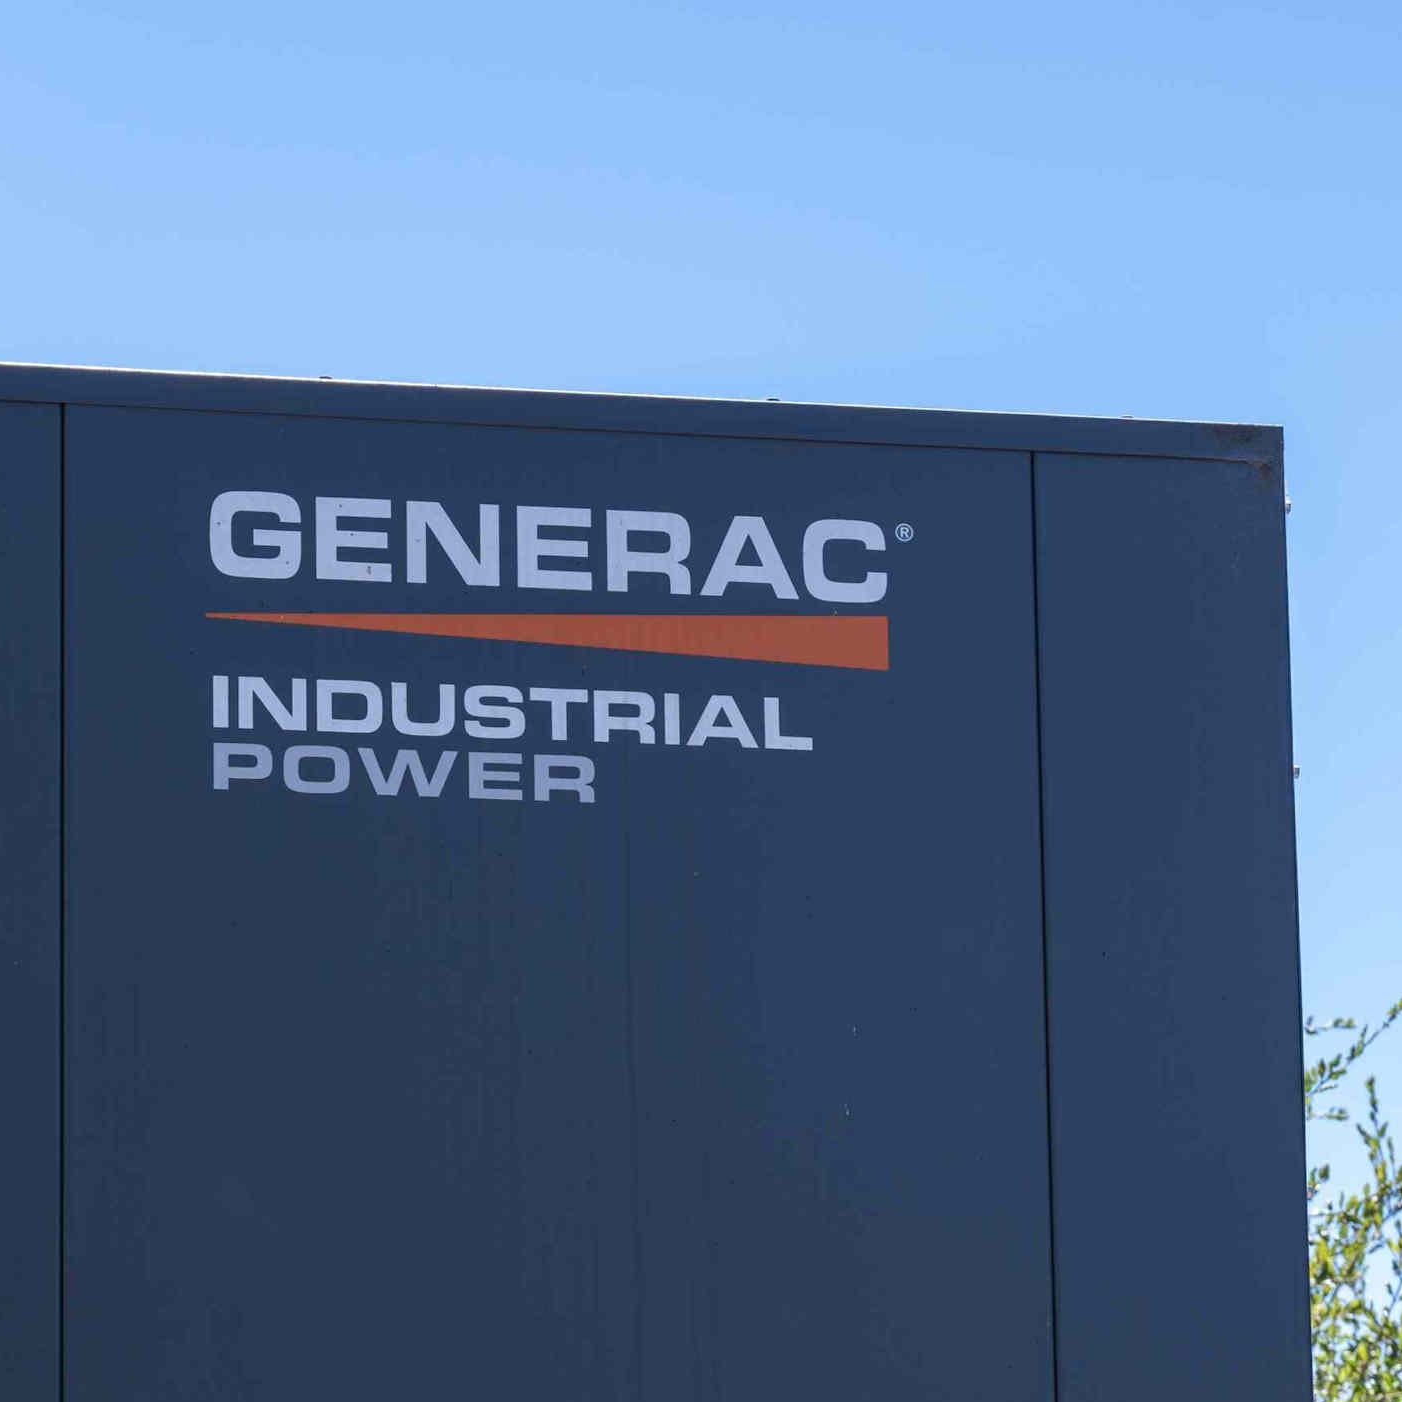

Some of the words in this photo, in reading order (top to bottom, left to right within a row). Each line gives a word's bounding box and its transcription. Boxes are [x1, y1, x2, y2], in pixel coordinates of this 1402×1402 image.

[209, 491, 888, 603] GENERAC
[212, 675, 814, 751] INDUSTRIAL
[212, 743, 596, 803] POWER
